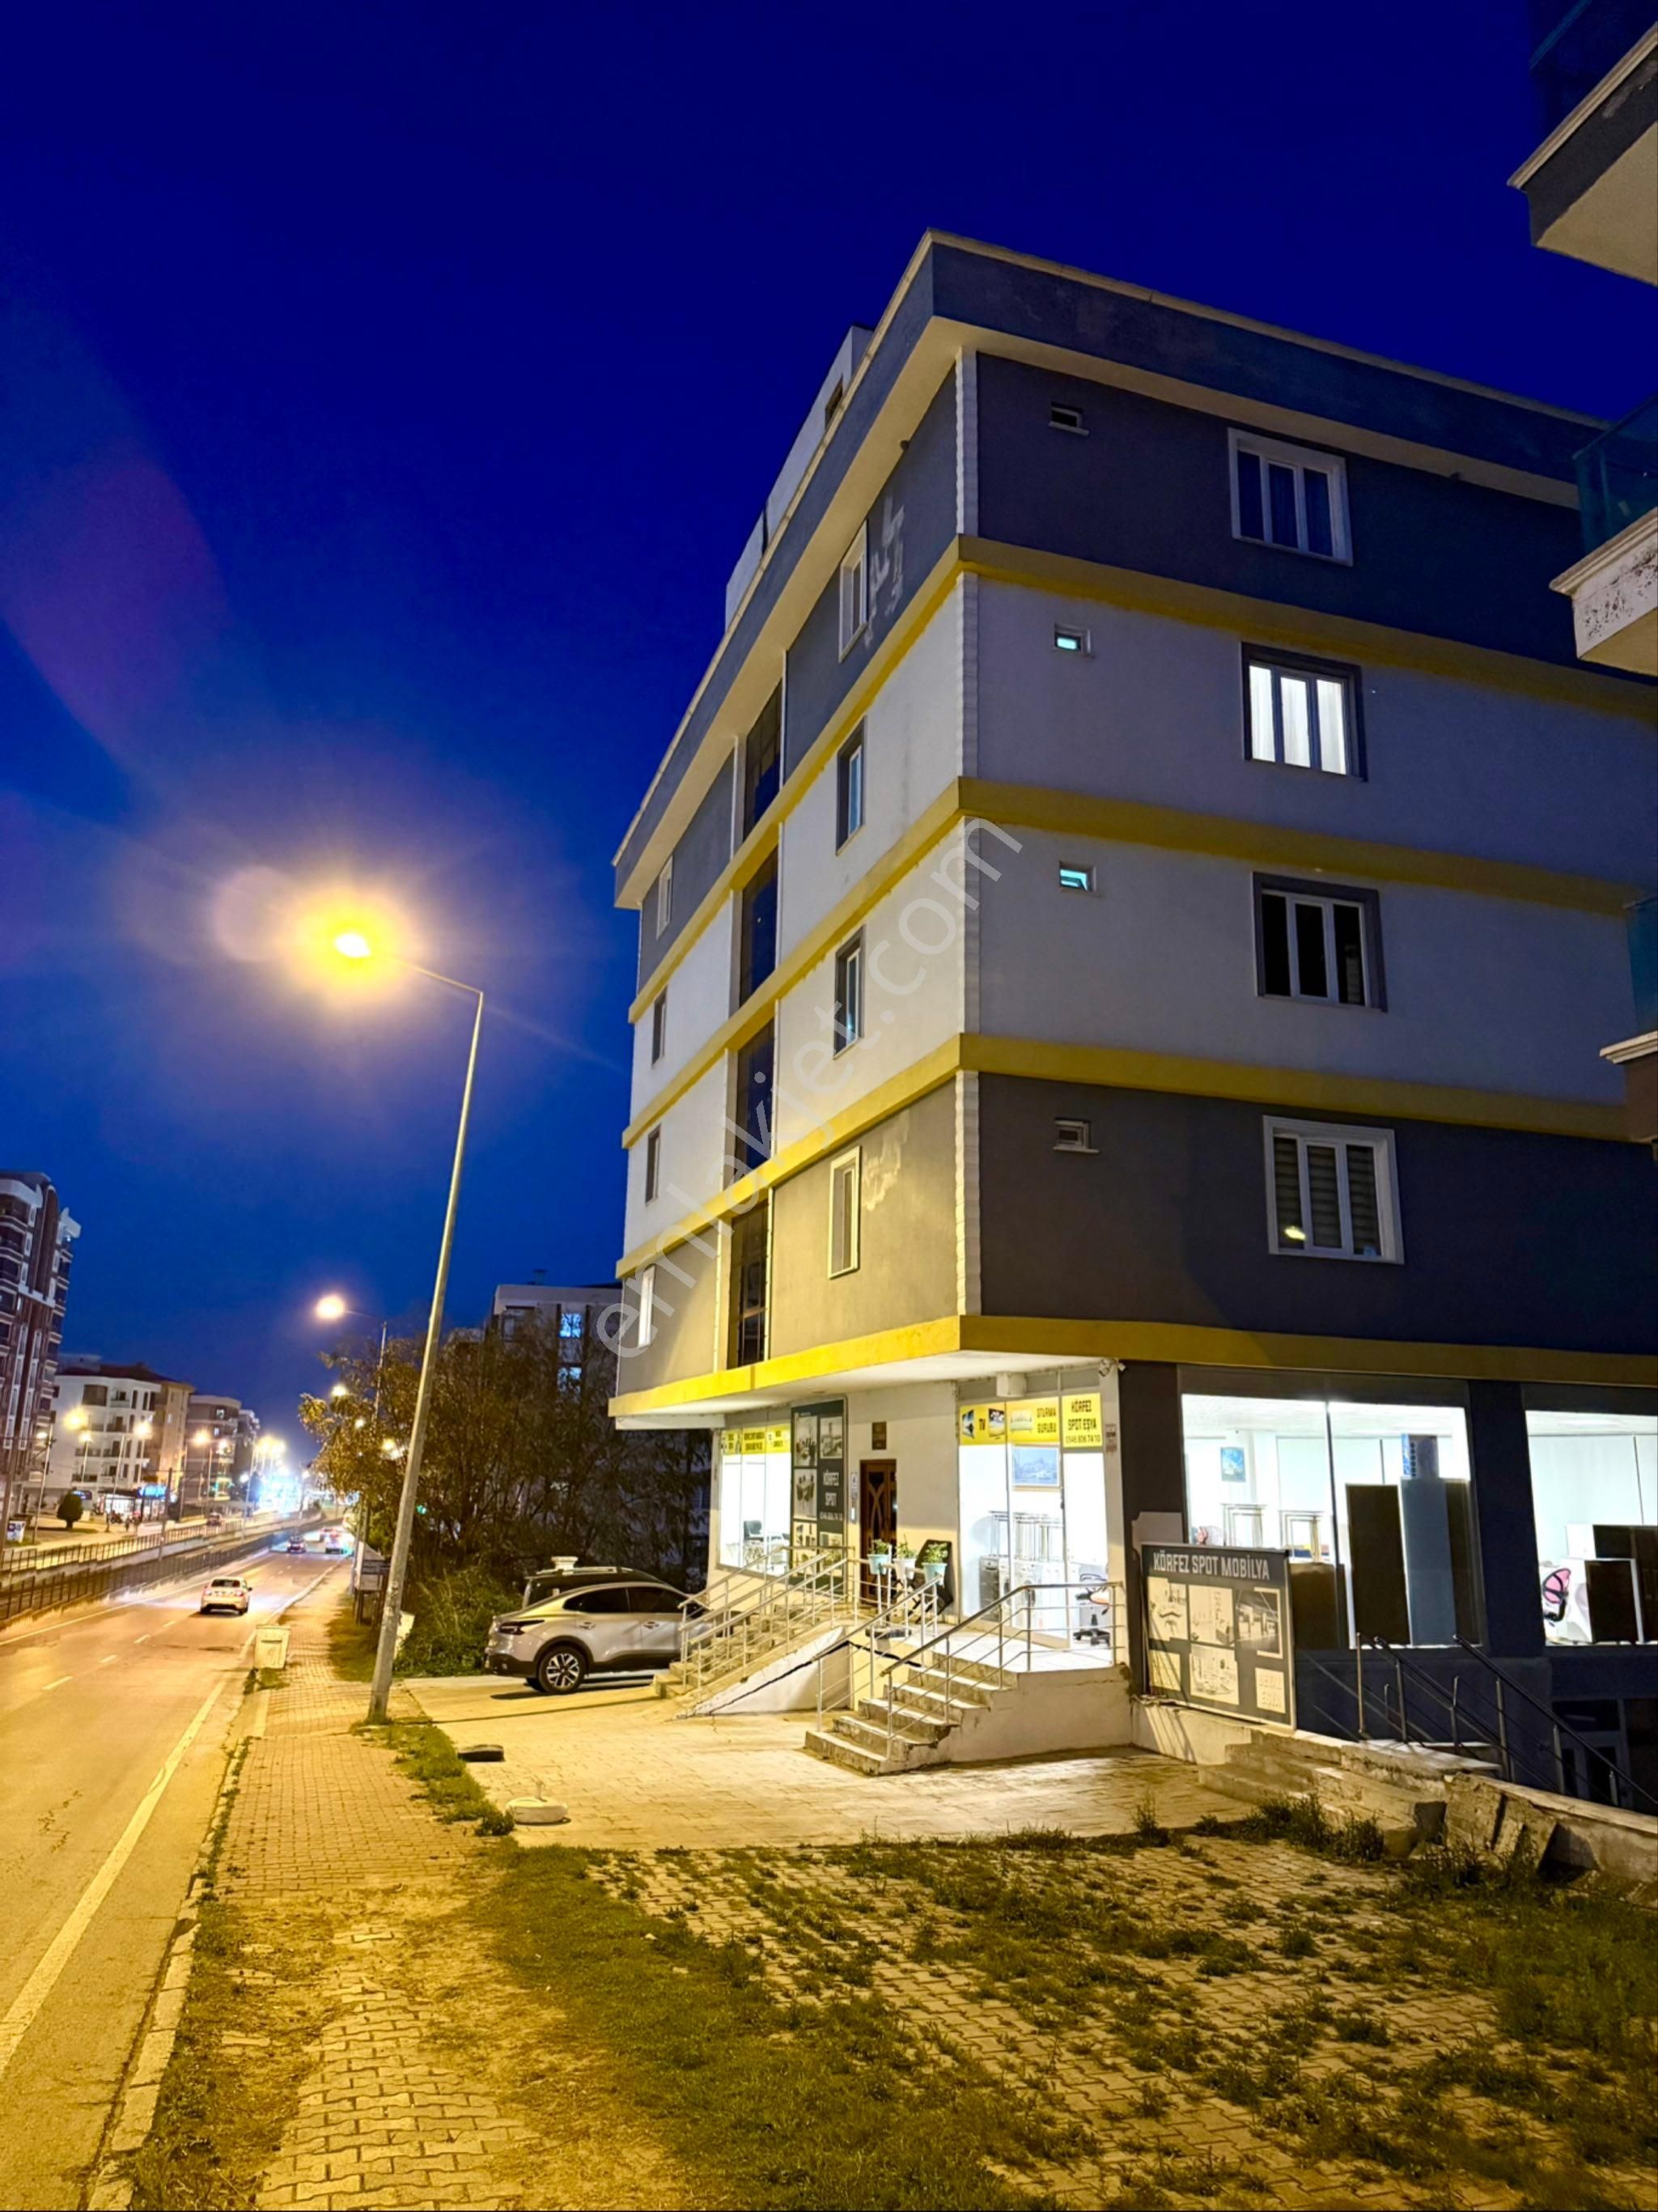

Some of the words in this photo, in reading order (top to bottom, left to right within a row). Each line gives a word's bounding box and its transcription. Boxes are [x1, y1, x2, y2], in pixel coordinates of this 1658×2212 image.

[1071, 1399, 1092, 1412] KÖRFEZ
[979, 1418, 986, 1430] TV
[1068, 1418, 1082, 1431] SPOT
[1083, 1418, 1096, 1432] EŞYA
[823, 1469, 839, 1486] KÖRFEZ
[825, 1492, 837, 1506] SPOT
[1153, 1549, 1189, 1574] KÖRFEZ
[1191, 1555, 1219, 1576] SPOT
[1221, 1555, 1270, 1581] MOBİLYA
